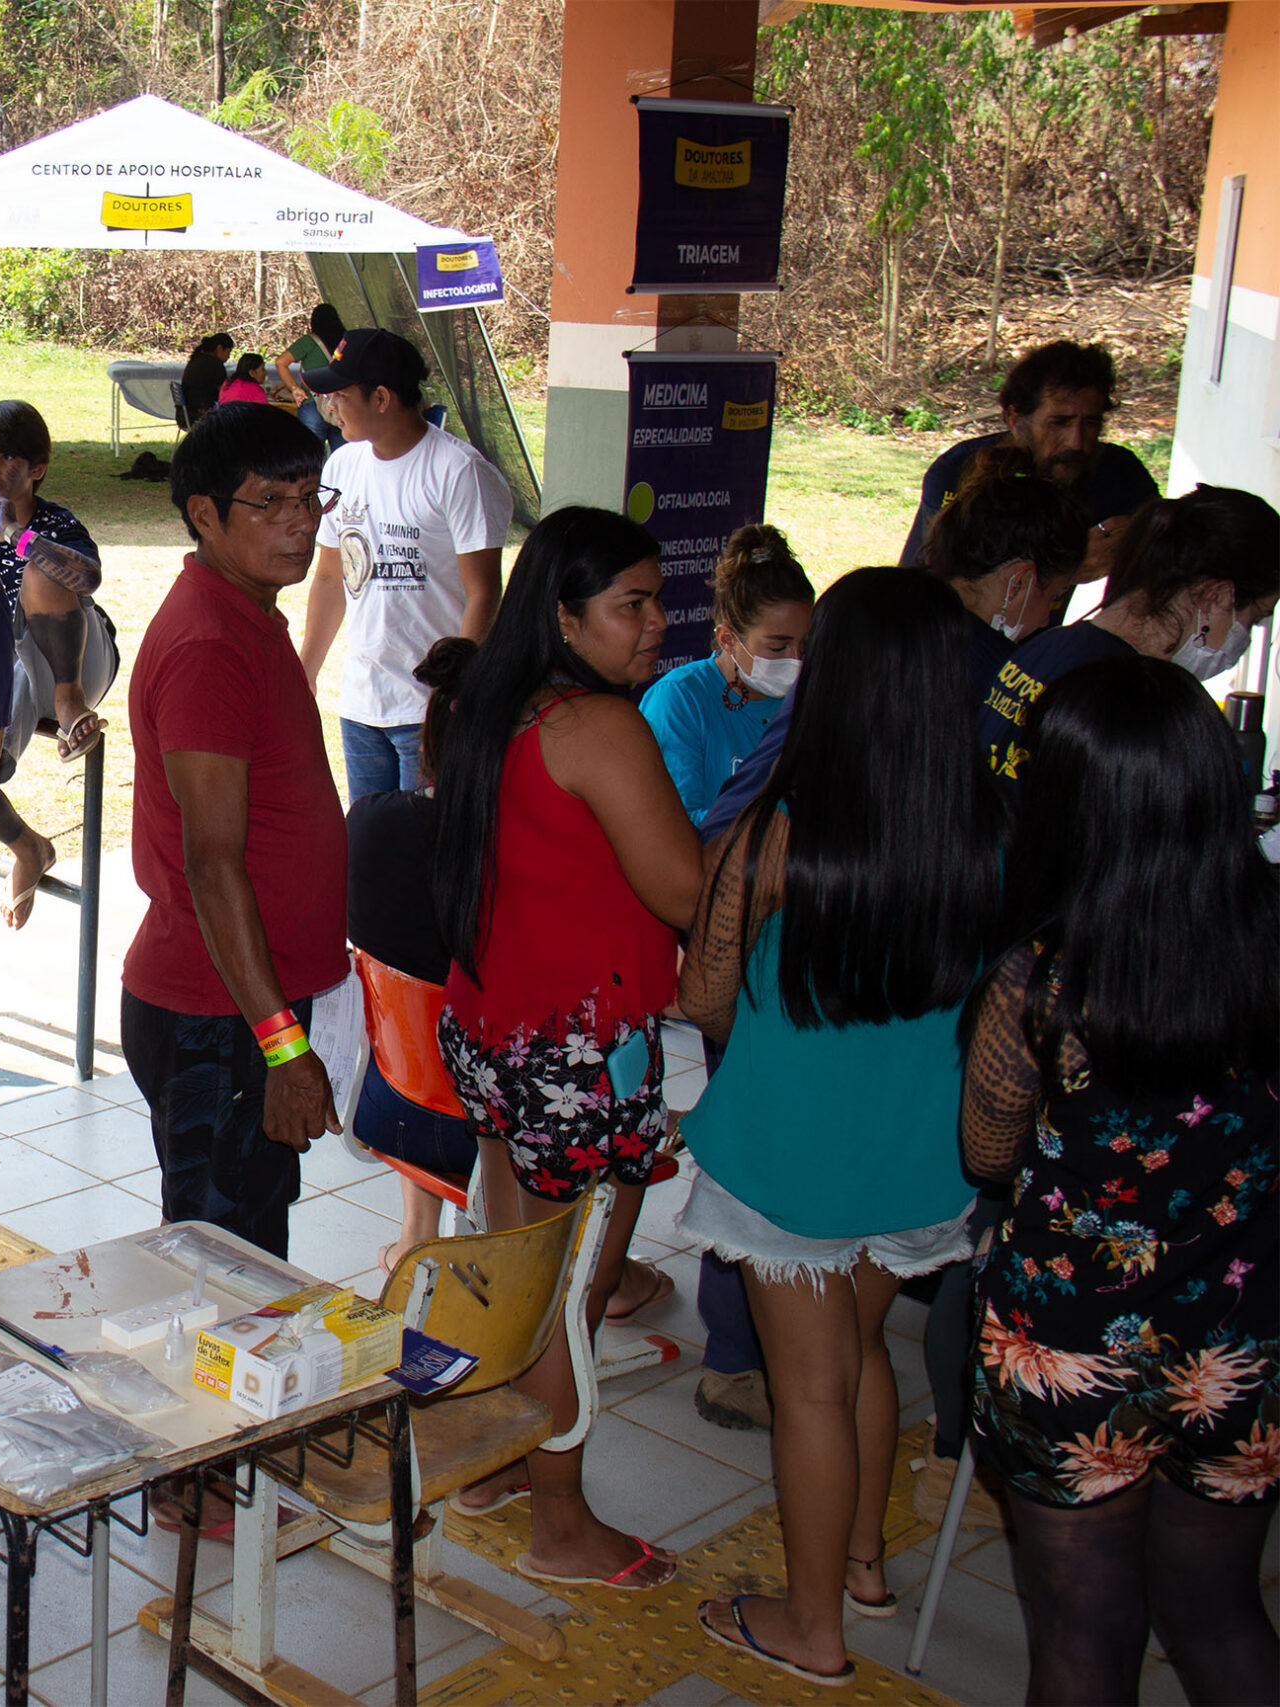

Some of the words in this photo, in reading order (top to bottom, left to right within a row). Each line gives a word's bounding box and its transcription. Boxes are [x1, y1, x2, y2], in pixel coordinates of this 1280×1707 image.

[31, 164, 92, 176] CENTRO
[96, 164, 113, 176] DE
[119, 164, 166, 176] APOIO
[170, 165, 263, 178] HOSPITALAR
[112, 200, 182, 213] DOUTORES
[276, 207, 330, 226] abrigo
[335, 210, 373, 224] rural
[678, 245, 740, 264] TRIAGEM
[423, 282, 498, 299] INFECTOLOGISTA
[642, 383, 708, 406] MEDICINA
[633, 427, 713, 445] ESPECIALIDADES
[657, 491, 731, 510] OFTALMOLOGIA
[658, 537, 718, 556] INECOLOGIA
[658, 555, 715, 577] BSTETRÍCIA
[687, 603, 713, 623] MÉDI
